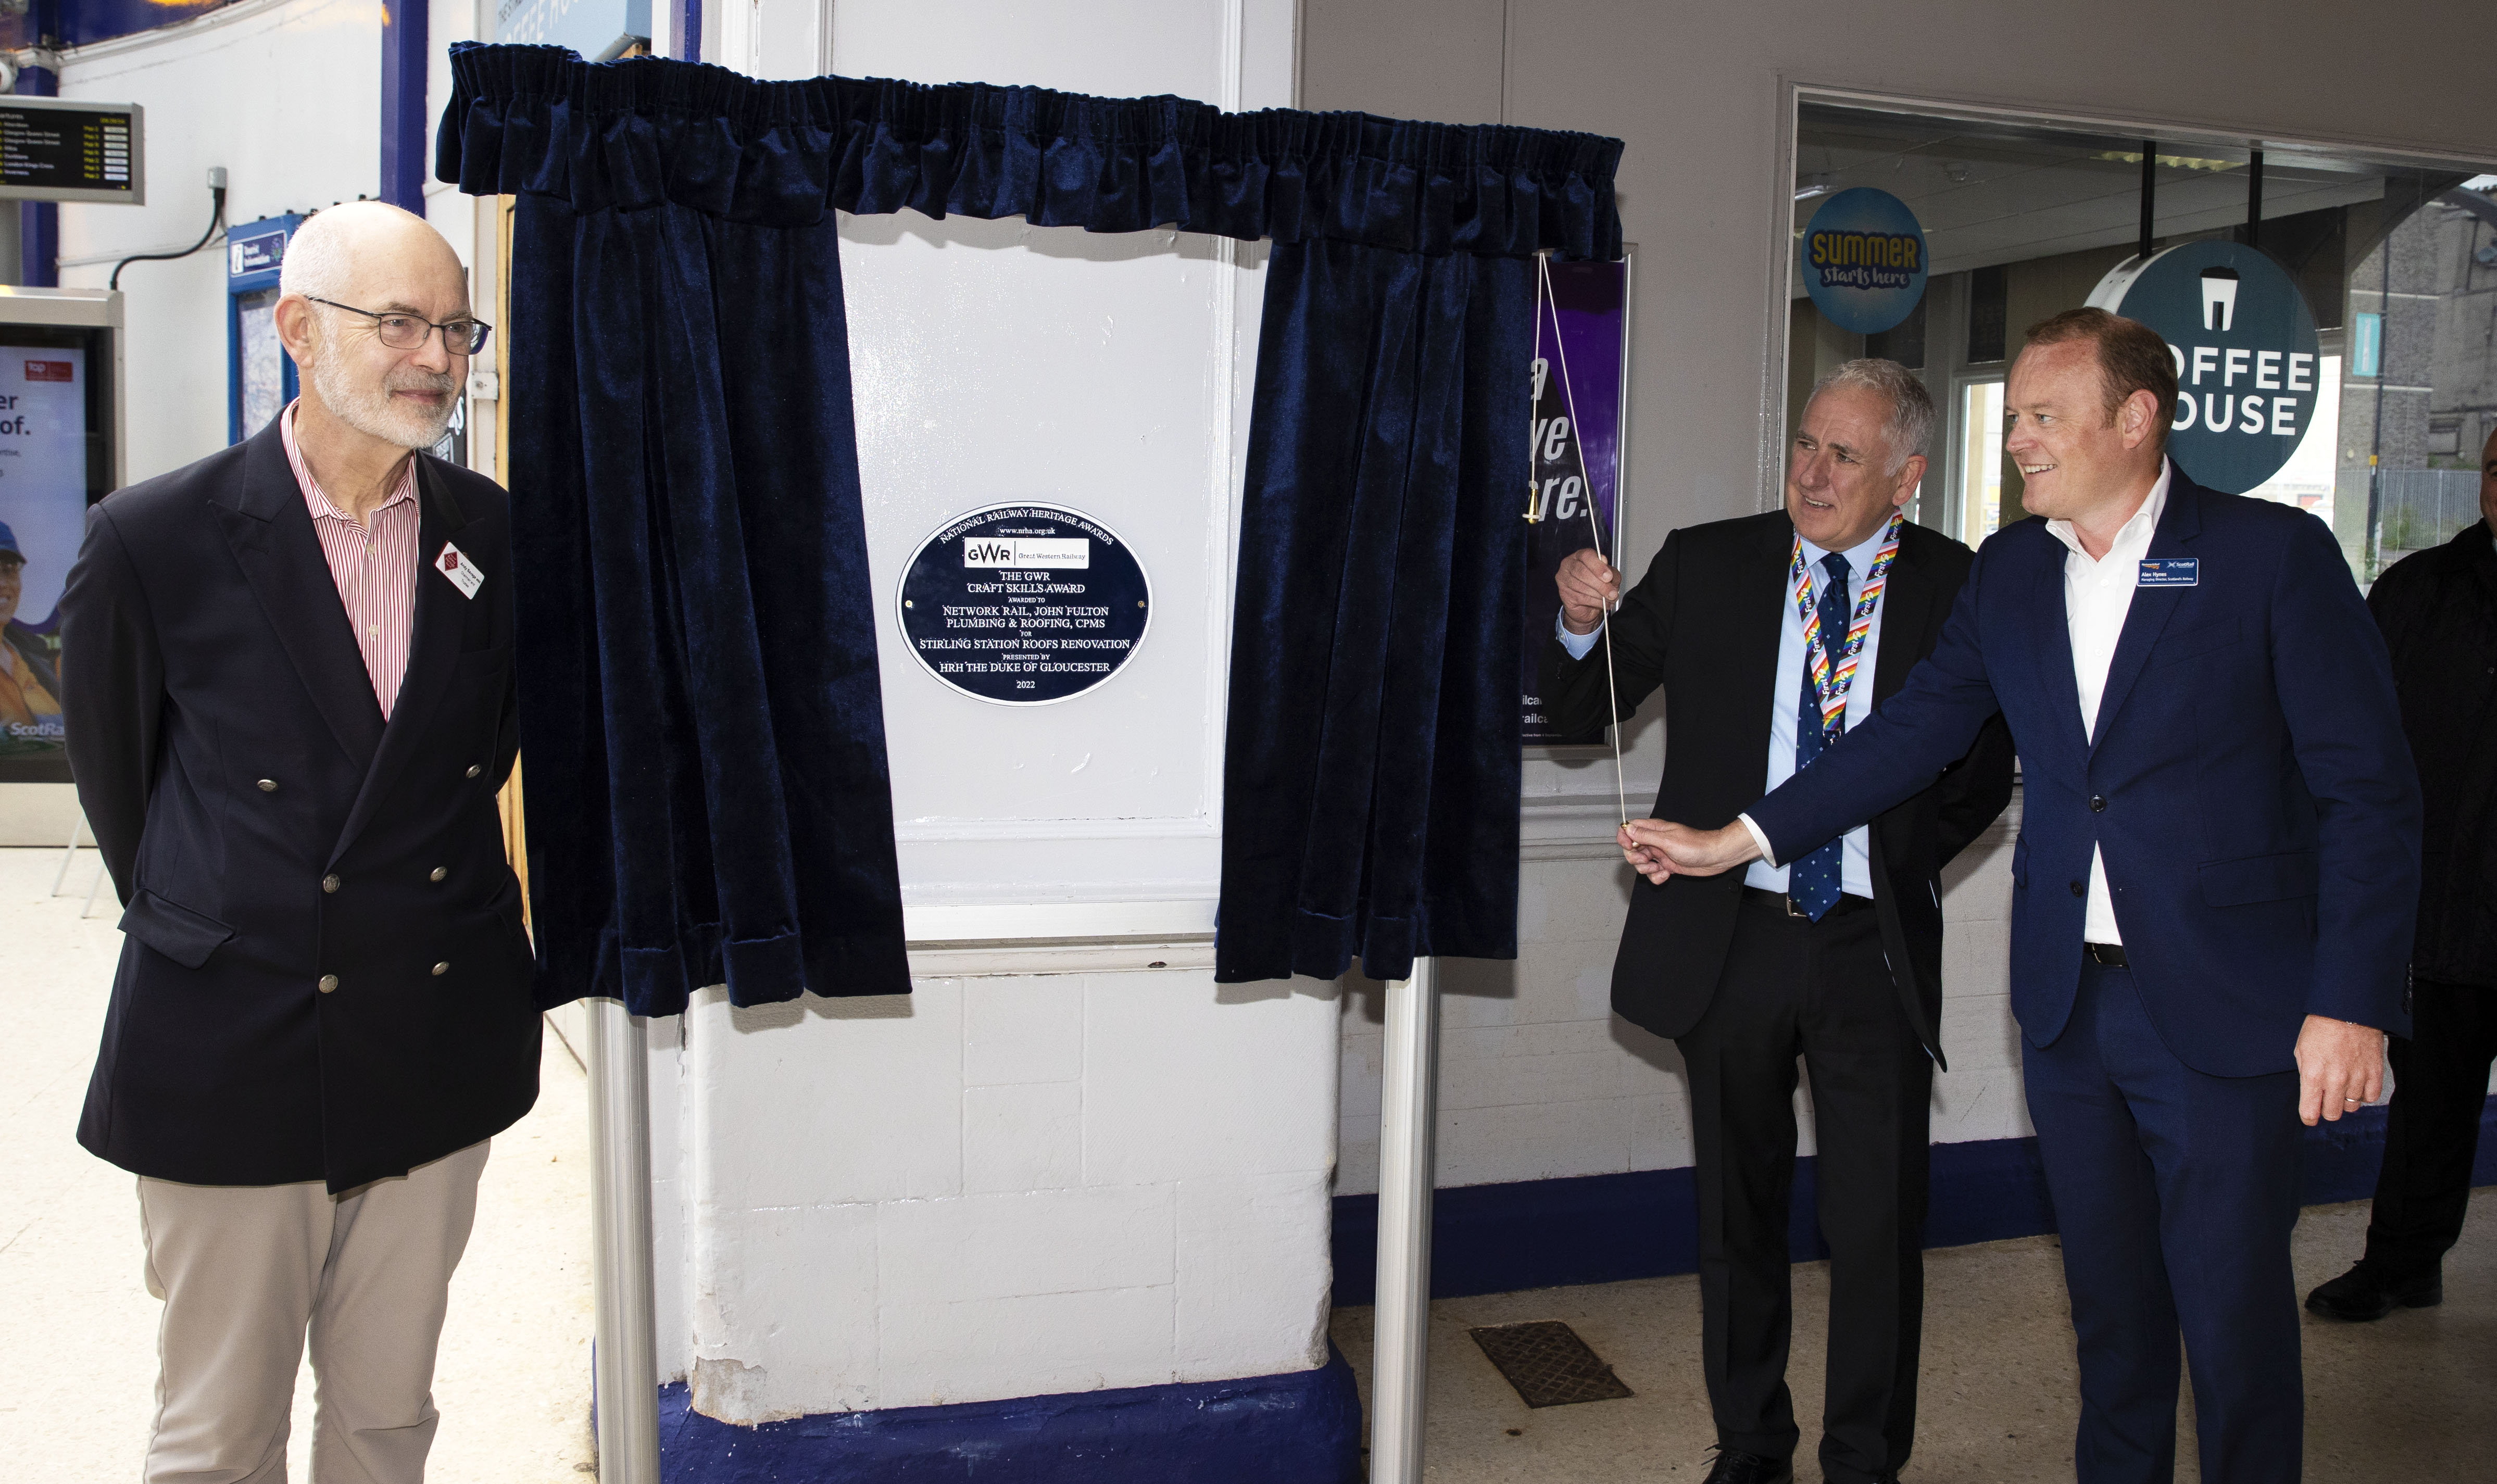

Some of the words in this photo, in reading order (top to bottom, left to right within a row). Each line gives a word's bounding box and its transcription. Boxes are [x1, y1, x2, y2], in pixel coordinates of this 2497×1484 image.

[1824, 266, 1870, 285] starts
[1873, 268, 1908, 285] here
[1529, 476, 1588, 521] re.
[940, 516, 986, 544] NATIONAL
[986, 509, 1030, 522] RAILWAY
[1031, 509, 1078, 525] HERITAGE
[1078, 521, 1114, 545] AWARDS
[1890, 526, 1898, 541] First
[968, 541, 1010, 563] GWR
[1000, 572, 1022, 581] THE
[1024, 572, 1050, 581] GWR
[1875, 562, 1886, 577] First
[968, 584, 1004, 593] CRAFT
[1006, 584, 1044, 593] SKILLS
[1046, 584, 1085, 593] AWARD
[943, 606, 999, 615] NETWORK
[1002, 607, 1032, 617] RAIL,
[1034, 607, 1063, 616] JOHN
[1066, 607, 1109, 616] FULTON
[1803, 597, 1812, 612] First
[1861, 601, 1871, 616] First
[947, 618, 1006, 628] PLUMBING
[1009, 619, 1017, 628] &
[1021, 619, 1073, 629] ROOFING,
[1075, 619, 1105, 628] CPMS
[920, 640, 971, 649] STIRLING
[974, 640, 1020, 649] STATION
[1023, 640, 1058, 649] ROOFS
[1061, 639, 1130, 649] RENOVATION
[1812, 636, 1821, 652] First
[1848, 640, 1859, 656] First
[940, 663, 963, 672] HRH
[966, 663, 987, 672] THE
[990, 663, 1021, 672] DUKE
[1023, 663, 1037, 672] OF
[1040, 663, 1110, 672] GLOUCESTER
[1821, 677, 1829, 695] First
[1835, 681, 1846, 695] First
[1522, 713, 1549, 724] ailca
